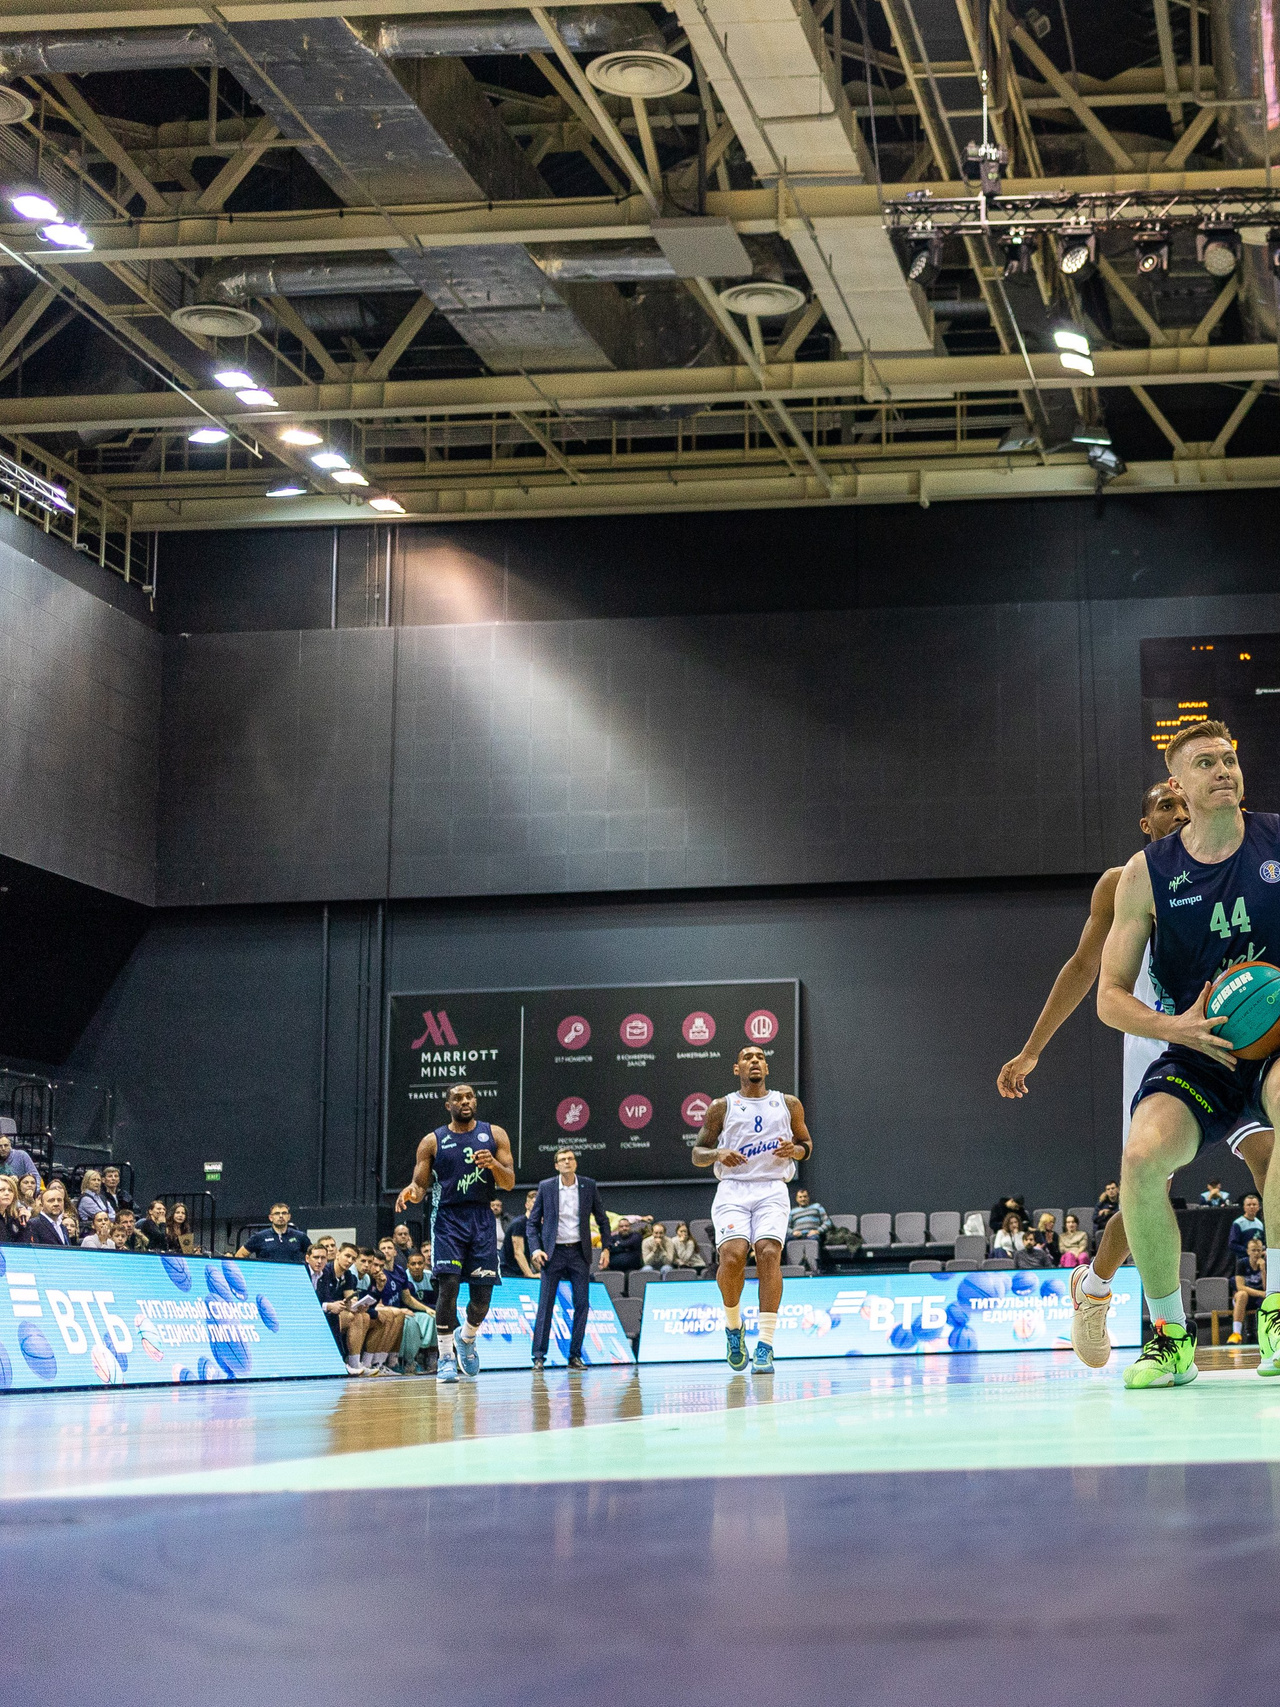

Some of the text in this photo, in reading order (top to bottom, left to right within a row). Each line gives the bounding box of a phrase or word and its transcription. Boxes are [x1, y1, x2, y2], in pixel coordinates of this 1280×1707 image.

[1169, 894, 1203, 908] Kempa
[1209, 896, 1252, 939] 44
[1210, 971, 1254, 1015] SIBUR
[421, 1049, 499, 1063] MARRIOTT
[420, 1065, 467, 1077] MINSK
[408, 1092, 439, 1100] TRAVEL
[1166, 1075, 1214, 1113] евроопт
[625, 1105, 647, 1118] VIP
[754, 1115, 763, 1133] 8
[462, 1147, 474, 1164] 3
[136, 1297, 260, 1321] ТИТУЛЬНЫЙ СПОНСОР
[968, 1293, 1058, 1310] ТИТУЛЬНЫЙ
[868, 1295, 947, 1331] ВТБ
[982, 1307, 1045, 1323] ЕДИНОЙ
[44, 1289, 134, 1355] ВТБ
[160, 1320, 261, 1346] ЕДИНОЙ ЛИГИ ВТБ
